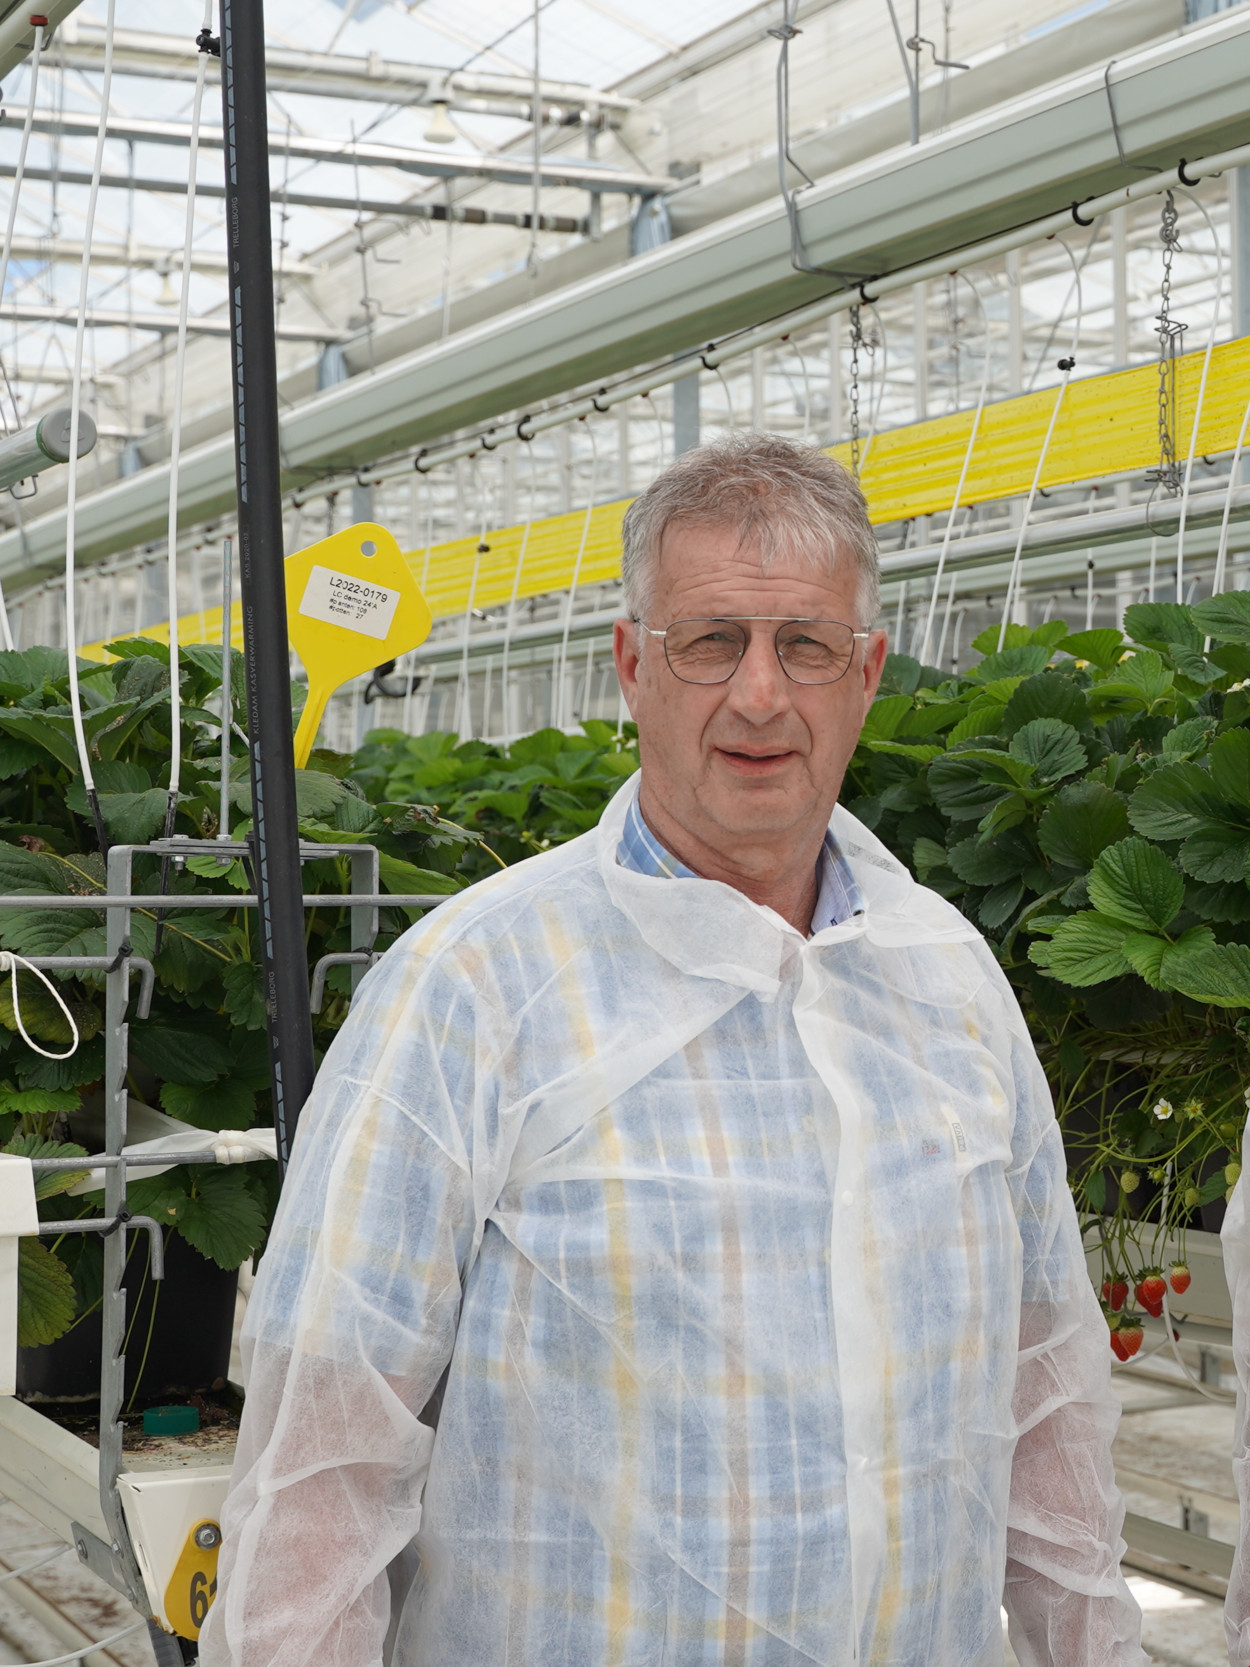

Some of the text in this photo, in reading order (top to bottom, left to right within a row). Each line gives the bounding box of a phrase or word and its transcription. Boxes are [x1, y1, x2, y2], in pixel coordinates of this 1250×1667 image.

[231, 197, 240, 249] TRELLEBORG
[329, 577, 388, 603] L2022-0179
[332, 590, 342, 598] LC
[344, 594, 362, 605] demo
[246, 606, 260, 735] KLEDAM KASVERWARMING
[268, 971, 277, 1023] TRELLEBORG
